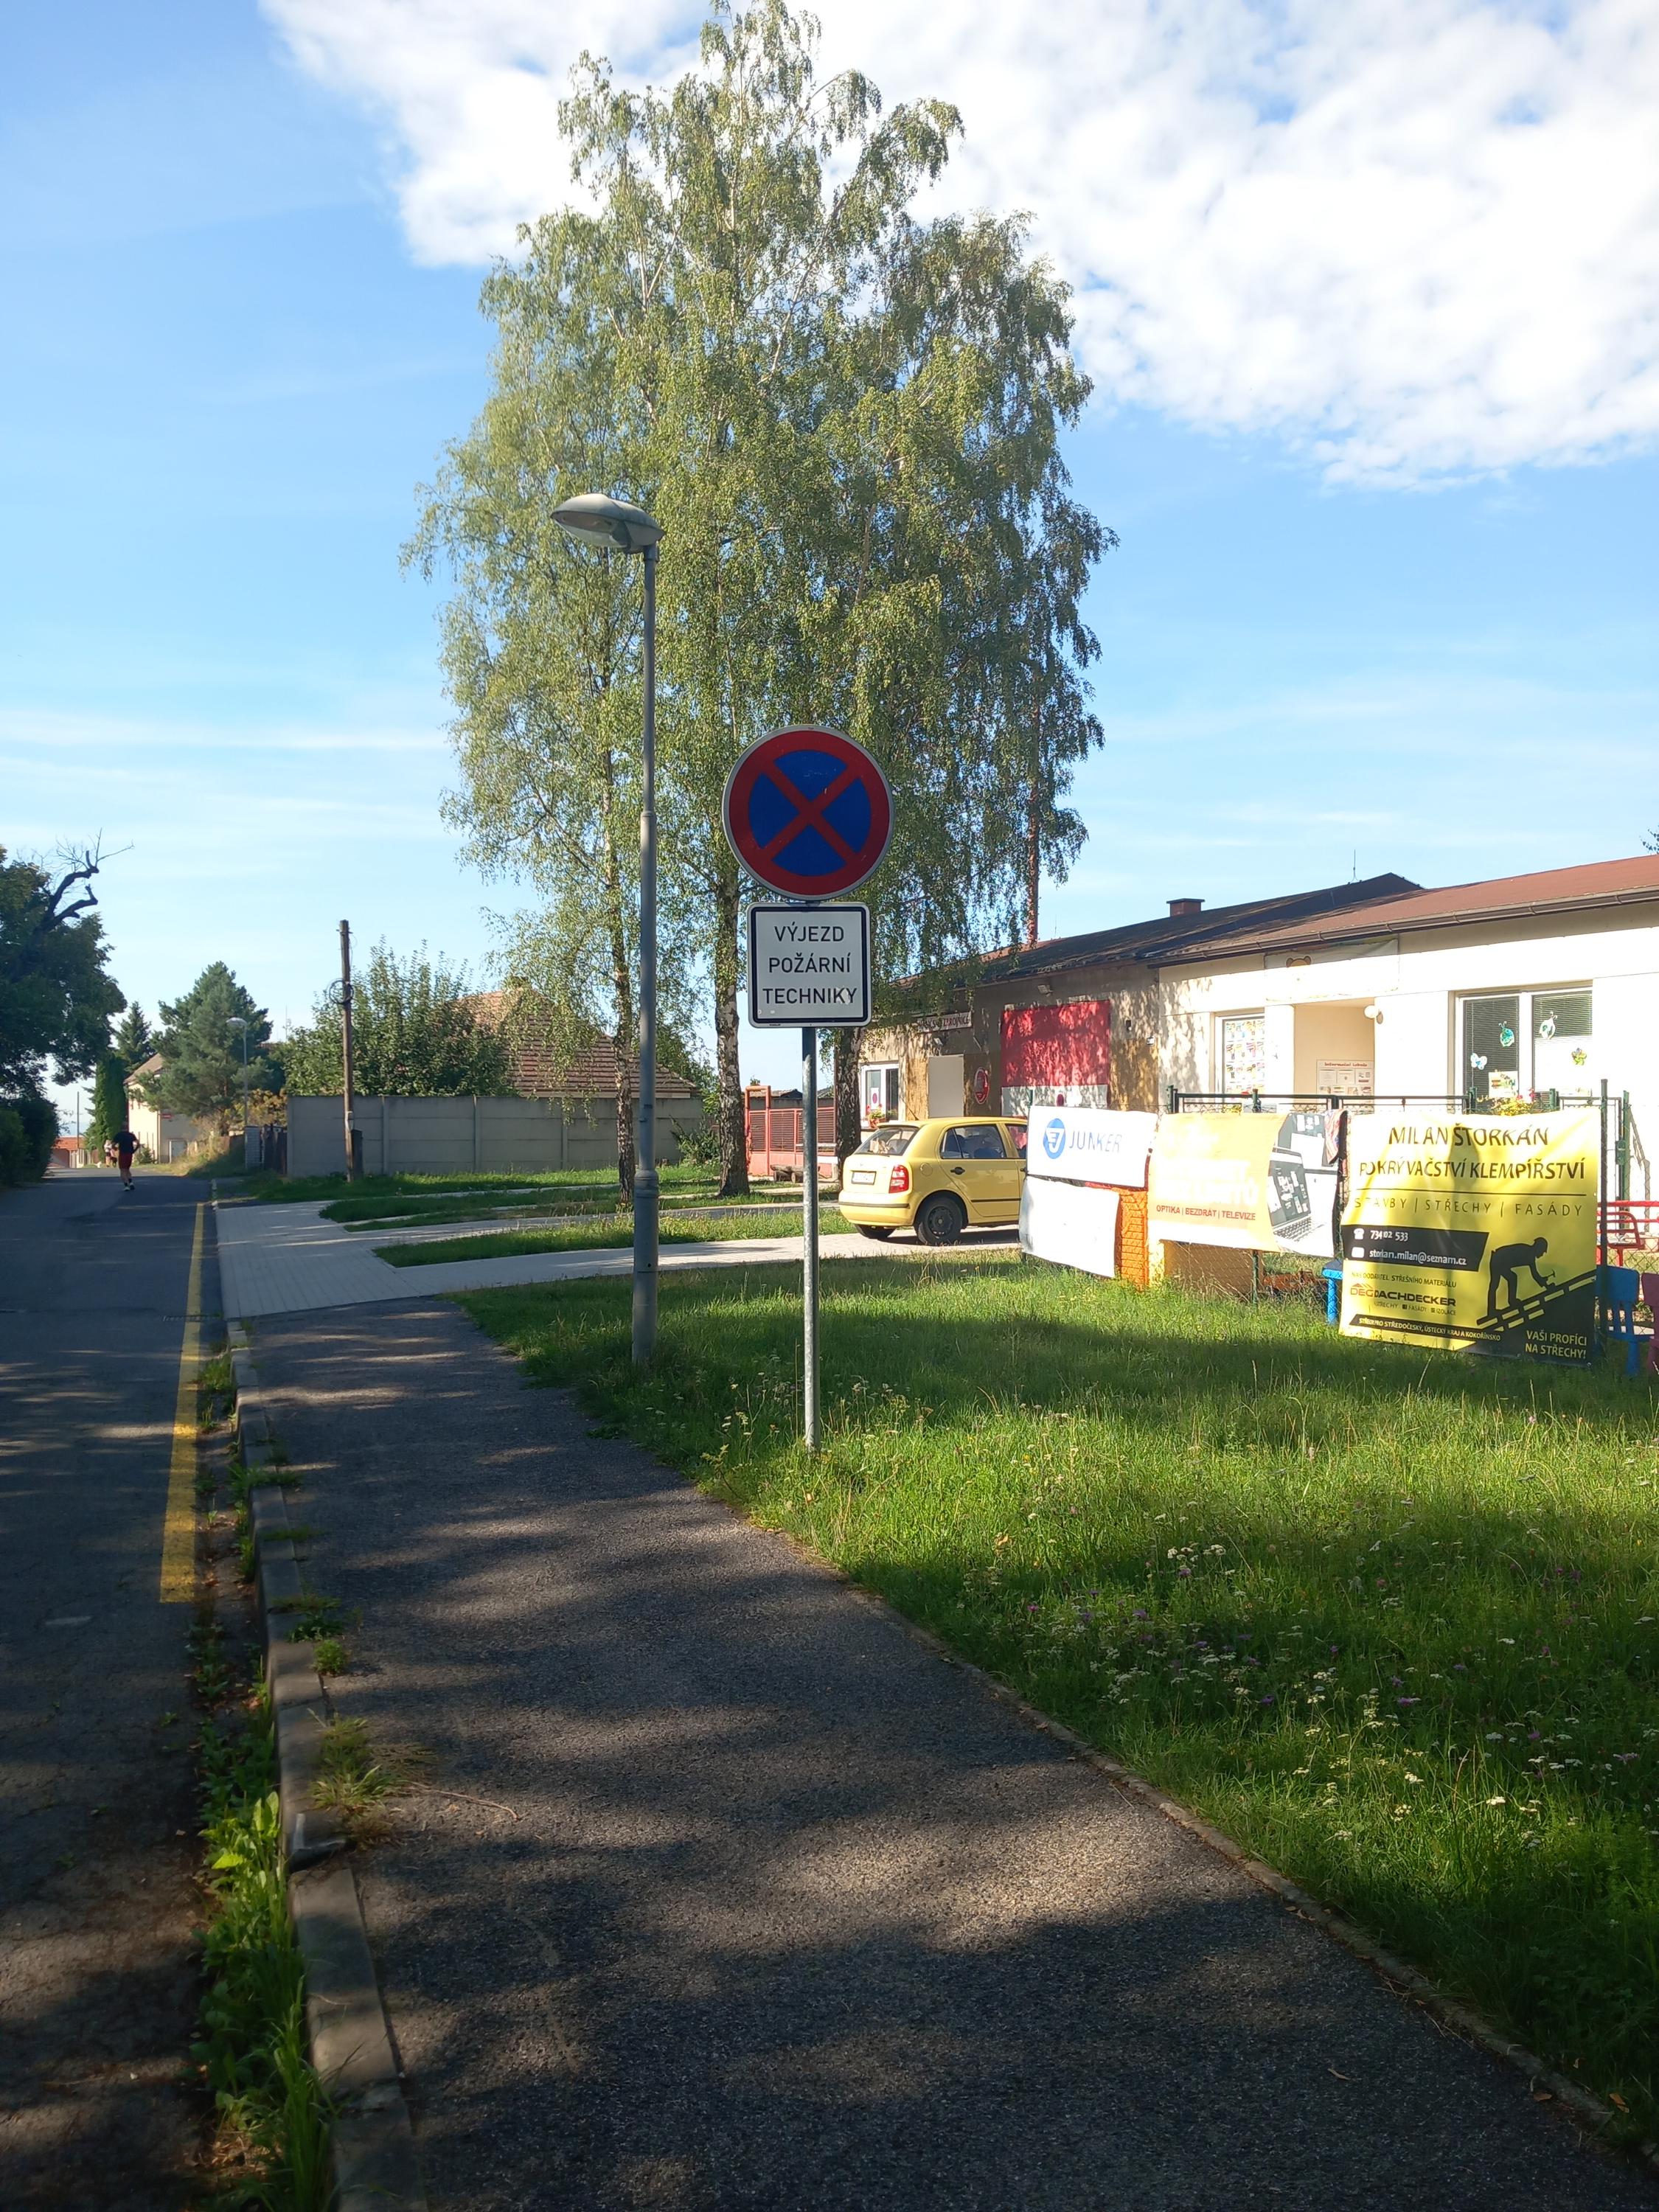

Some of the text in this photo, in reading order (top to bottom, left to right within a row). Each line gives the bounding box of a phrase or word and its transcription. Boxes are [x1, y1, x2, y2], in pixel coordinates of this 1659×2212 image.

[774, 922, 844, 942] VÝJEZD
[769, 953, 851, 973] POŽÁRNÍ
[762, 988, 858, 1004] TECHNIKY
[1069, 1130, 1122, 1153] JUNKER
[1388, 1123, 1548, 1146] MILAN ŠTORKÁN
[1470, 1158, 1586, 1180] KLEMPÍŘSTVÍ
[1156, 1205, 1180, 1214] OPTIKA
[1222, 1210, 1256, 1221] TELEVIZE
[1425, 1199, 1491, 1213] STŘECHY
[1515, 1202, 1582, 1216] FASÁDY
[1395, 1232, 1408, 1242] 533
[1391, 1274, 1423, 1284] STŘEŠNÍHO
[1424, 1279, 1457, 1288] MATERIÁLU
[1526, 1329, 1587, 1346] VAŠI PROFÍCI
[1525, 1343, 1587, 1359] NA STŘECHY!
